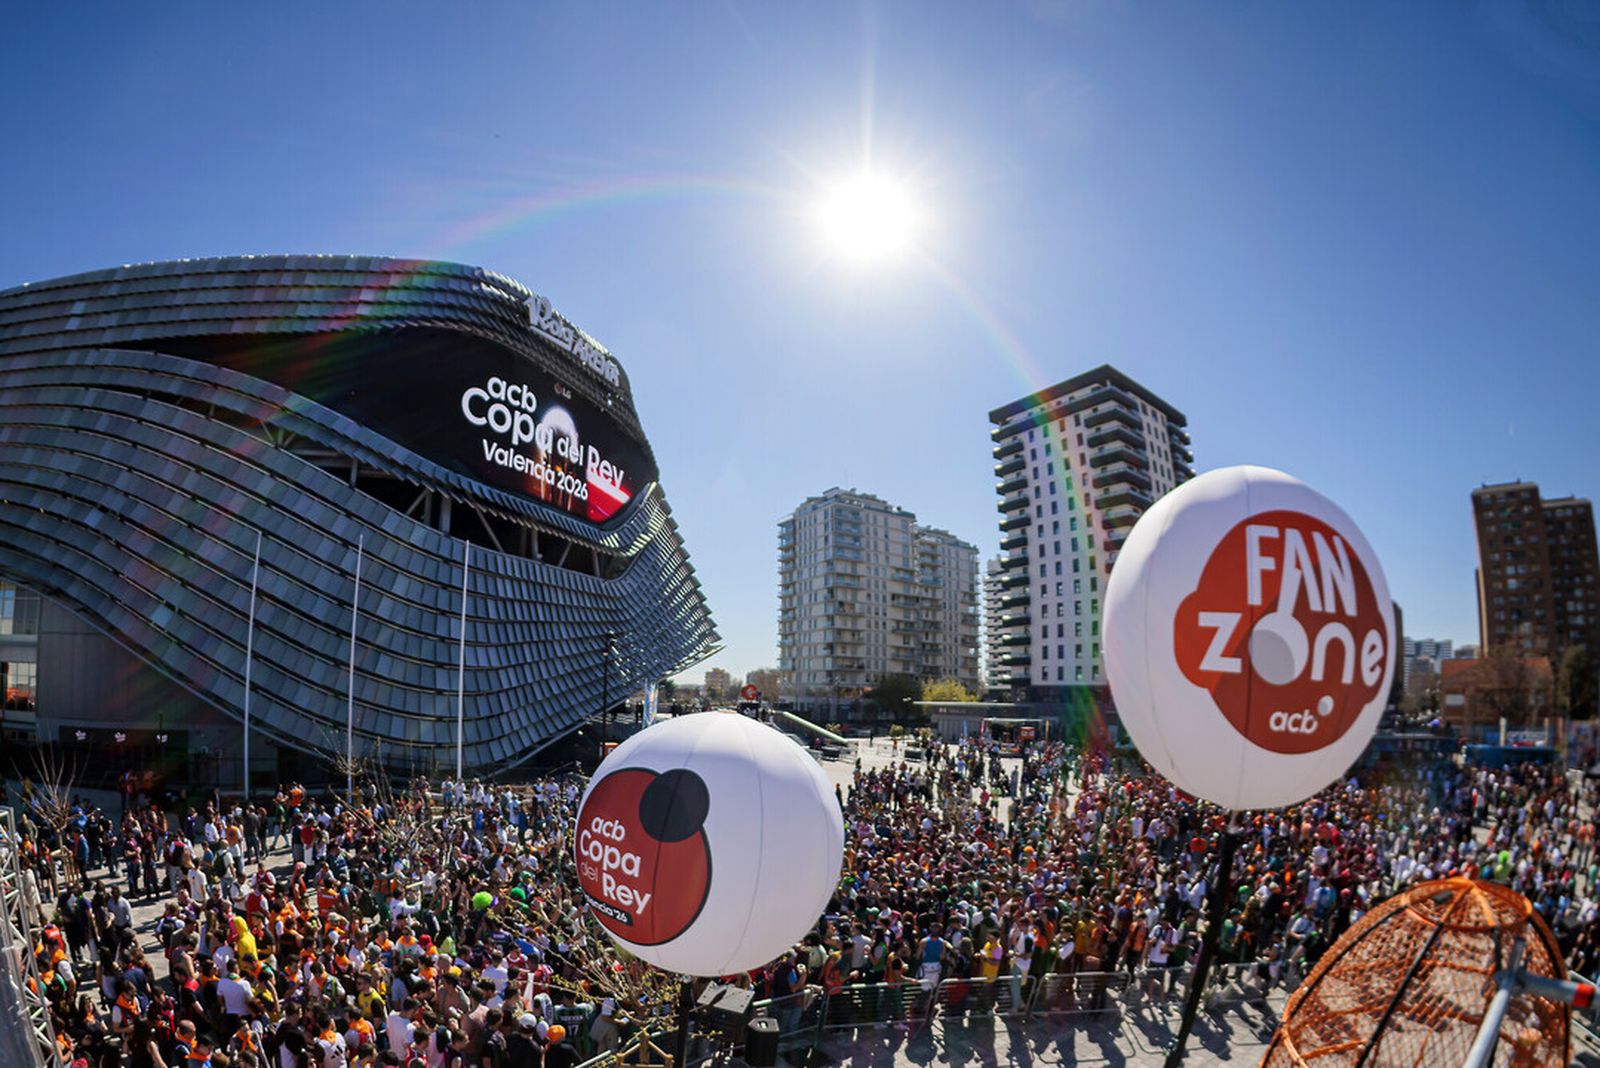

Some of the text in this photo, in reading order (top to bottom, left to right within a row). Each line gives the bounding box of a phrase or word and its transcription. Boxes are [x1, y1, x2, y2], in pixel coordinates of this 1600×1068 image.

[523, 296, 576, 352] Roig
[487, 376, 537, 413] acb
[461, 386, 625, 489] Copa del Rey
[482, 438, 589, 501] Valencia 2026
[1245, 524, 1358, 617] FAN
[1269, 709, 1319, 734] acb
[591, 816, 626, 843] acb
[579, 829, 641, 878] Copa
[580, 861, 598, 882] del
[602, 872, 651, 915] Rey
